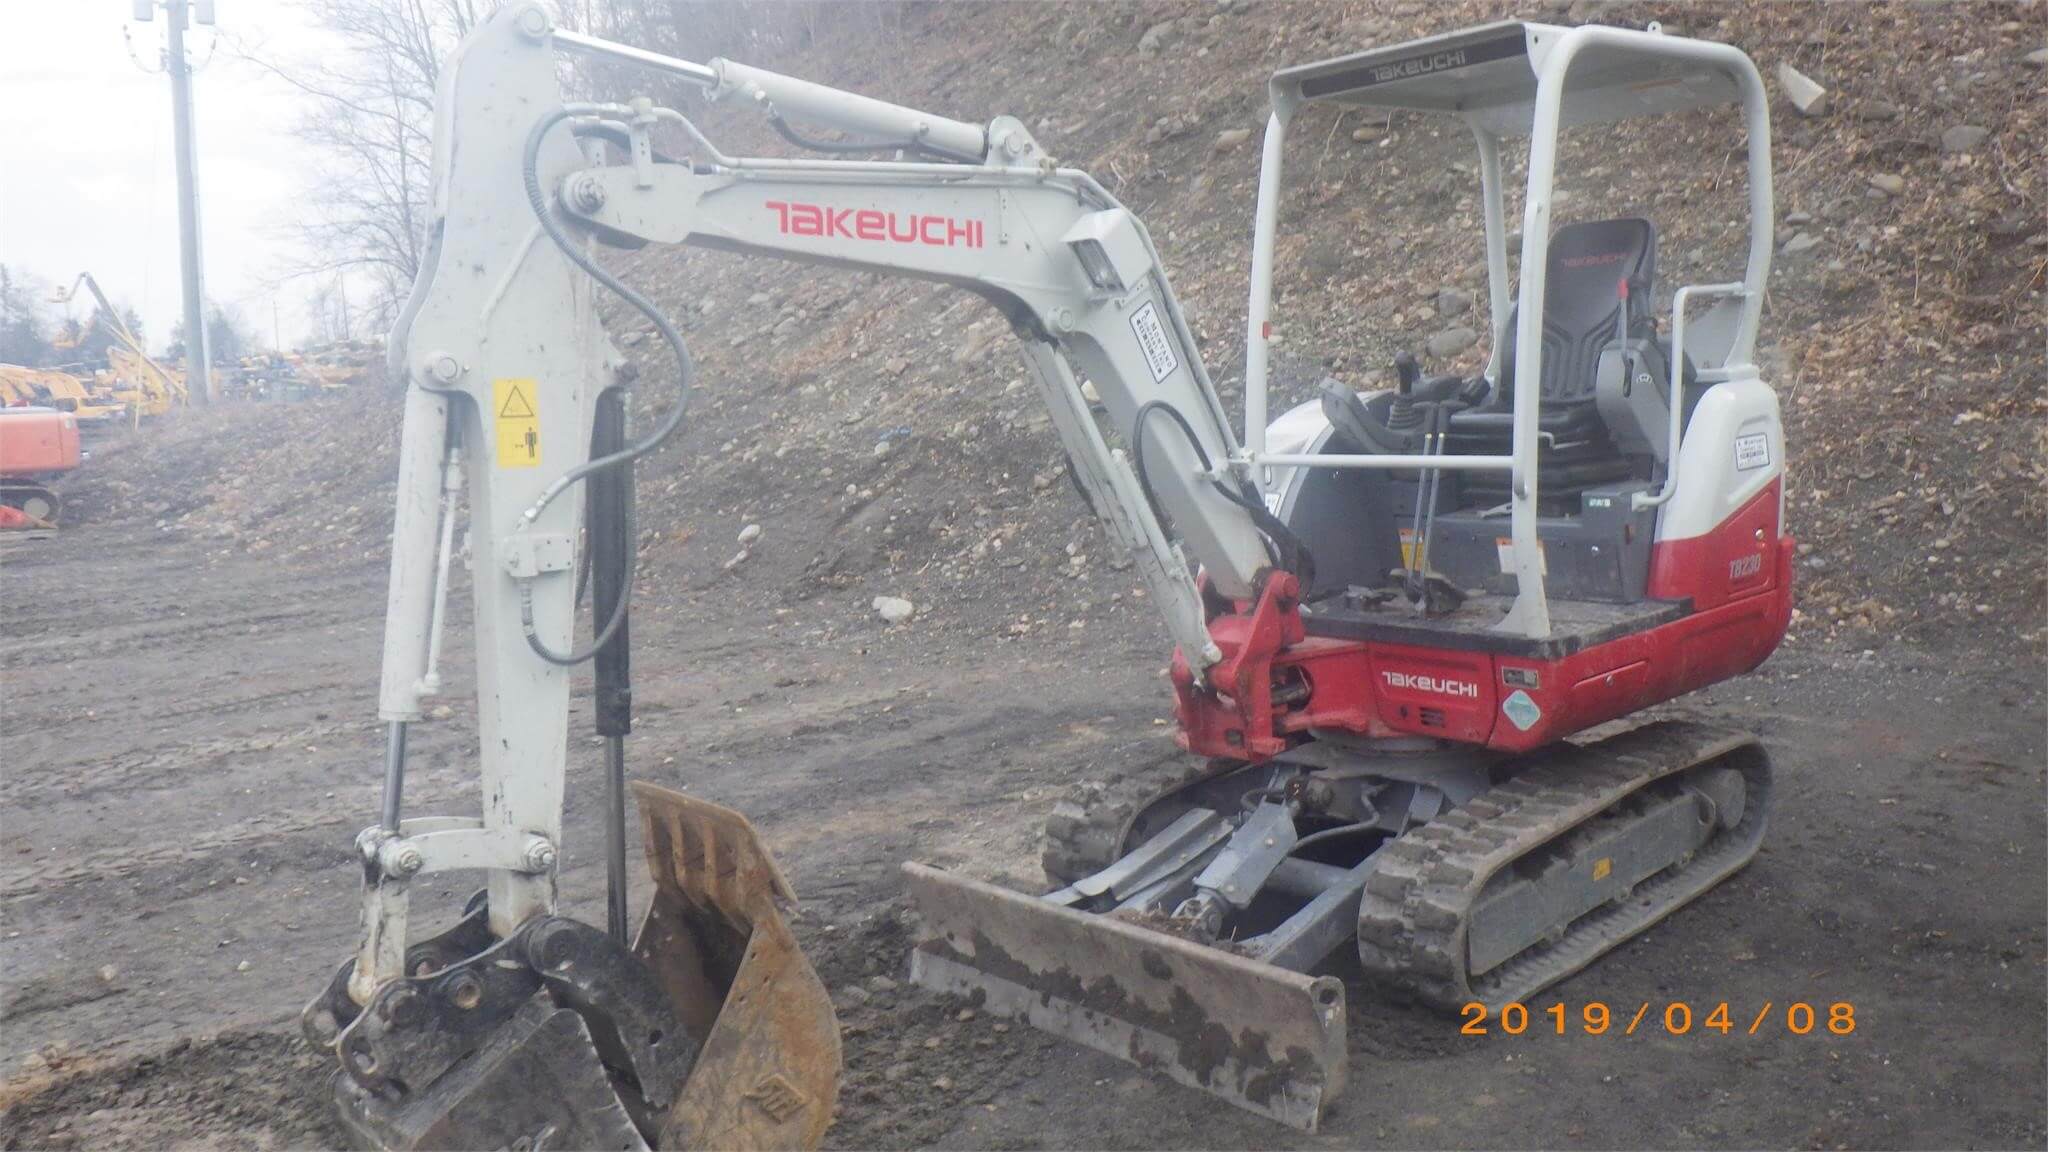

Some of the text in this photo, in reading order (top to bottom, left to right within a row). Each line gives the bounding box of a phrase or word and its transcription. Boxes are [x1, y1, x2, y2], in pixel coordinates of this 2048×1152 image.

[765, 201, 983, 248] TAKEUCHI
[1728, 553, 1762, 579] TB230
[1382, 671, 1478, 697] TAKEUCHI
